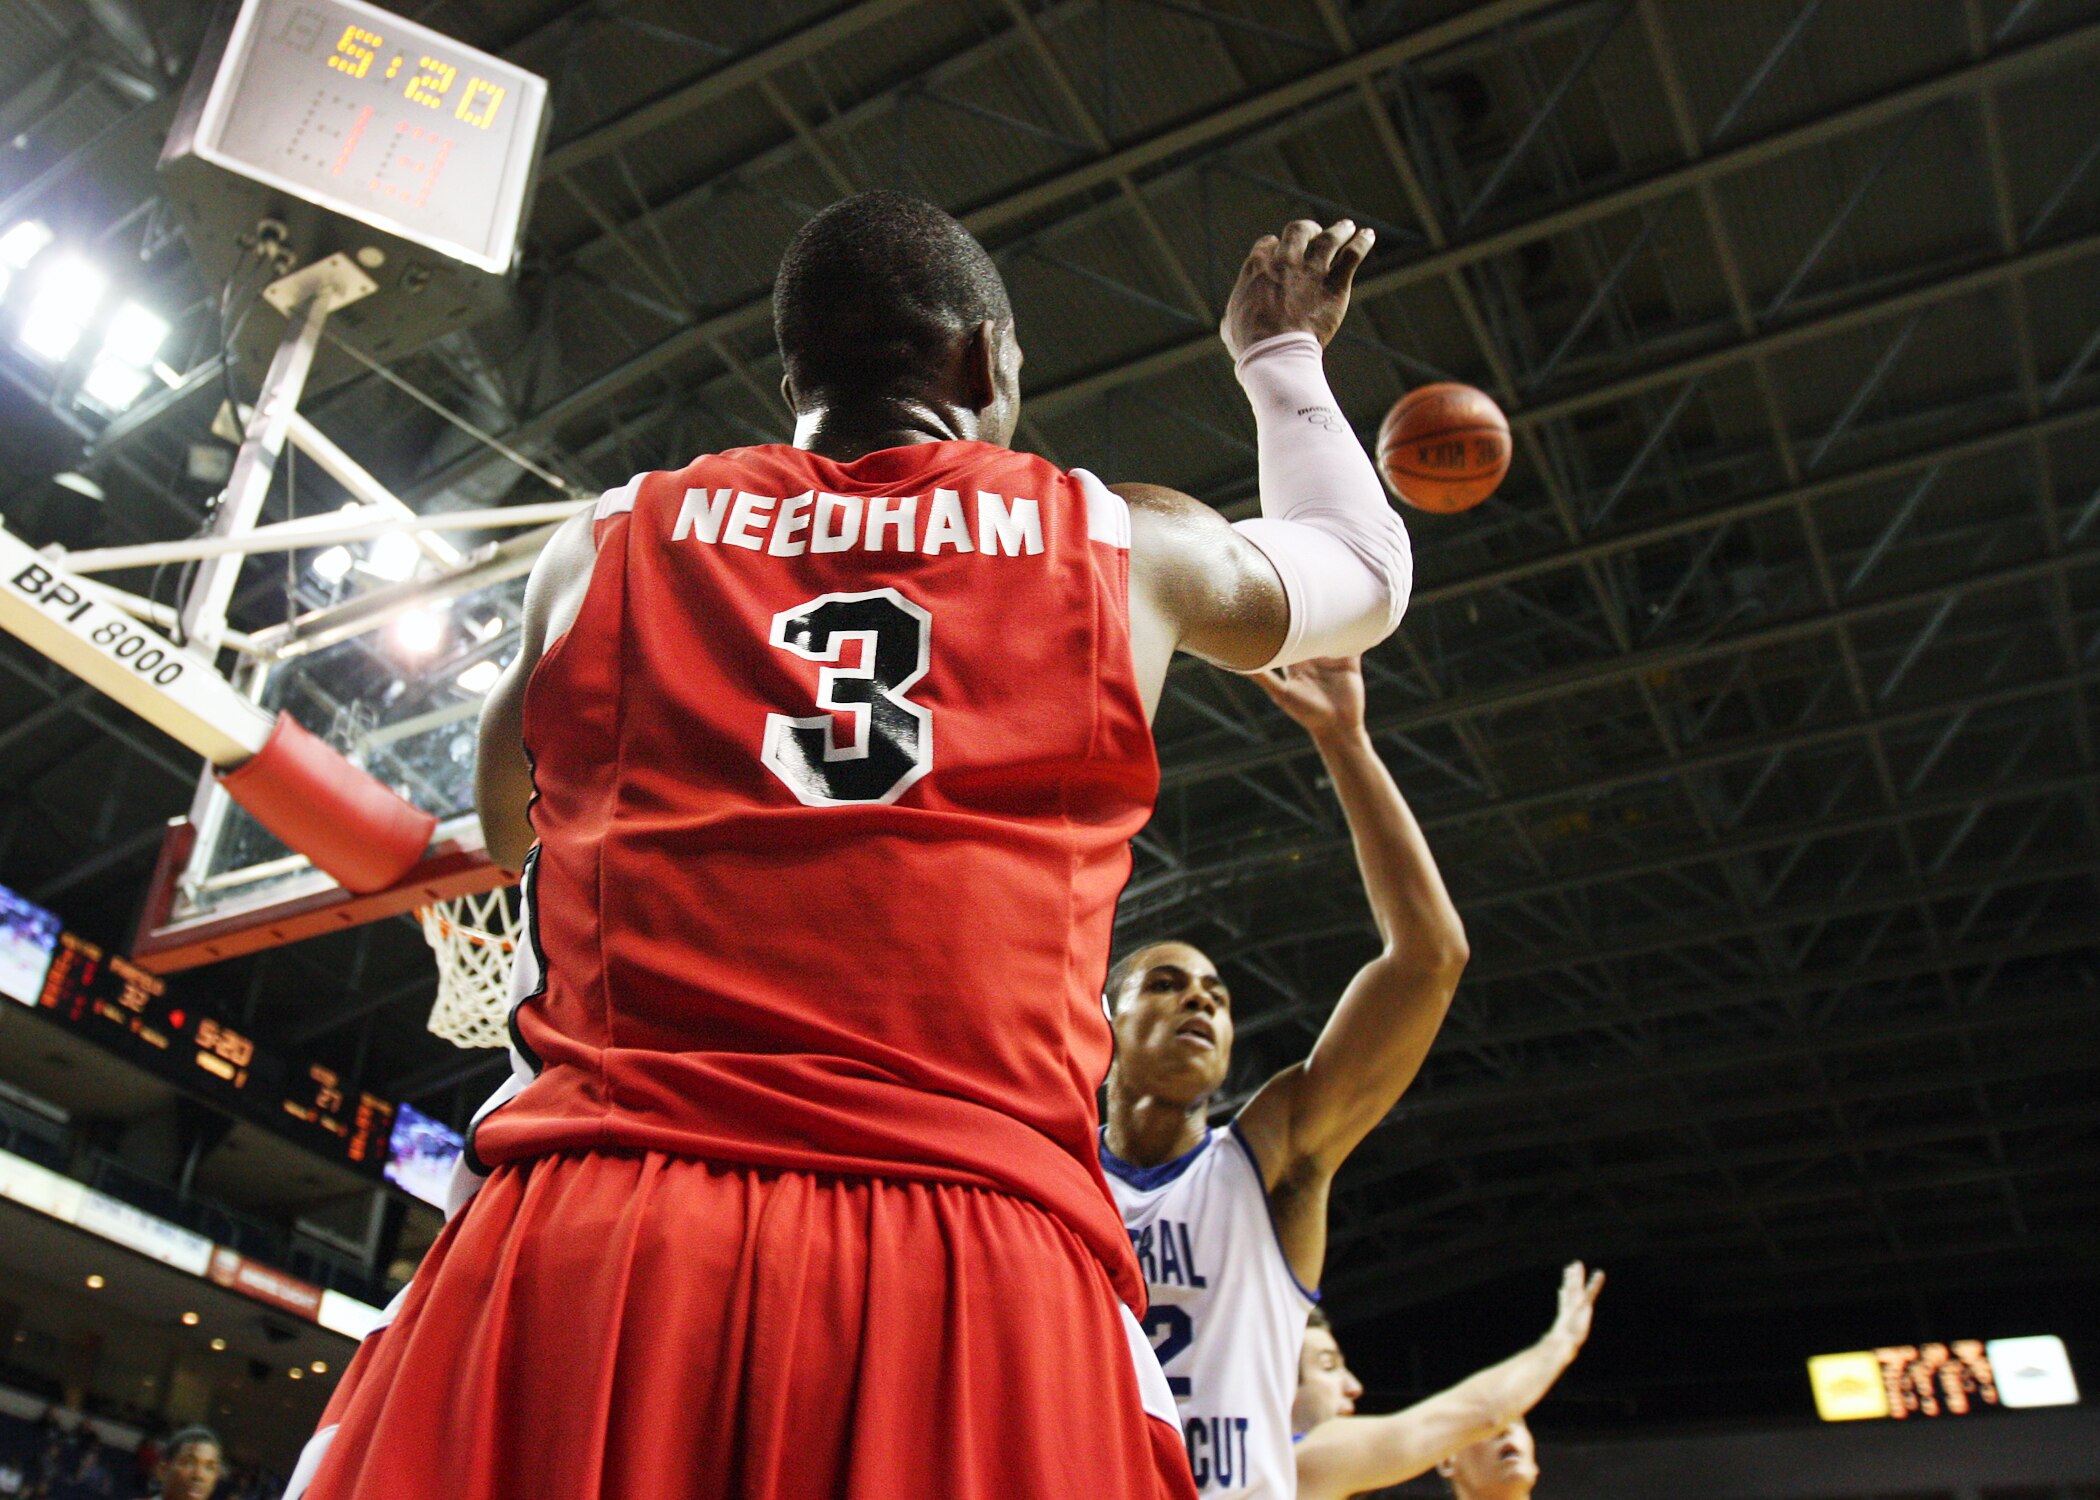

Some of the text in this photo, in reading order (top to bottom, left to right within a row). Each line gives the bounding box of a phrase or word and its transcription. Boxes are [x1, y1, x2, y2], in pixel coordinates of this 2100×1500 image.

[327, 25, 507, 130] 5:20
[671, 487, 1045, 557] NEEDHAM
[11, 563, 184, 686] BPI 8000
[761, 587, 933, 807] 3
